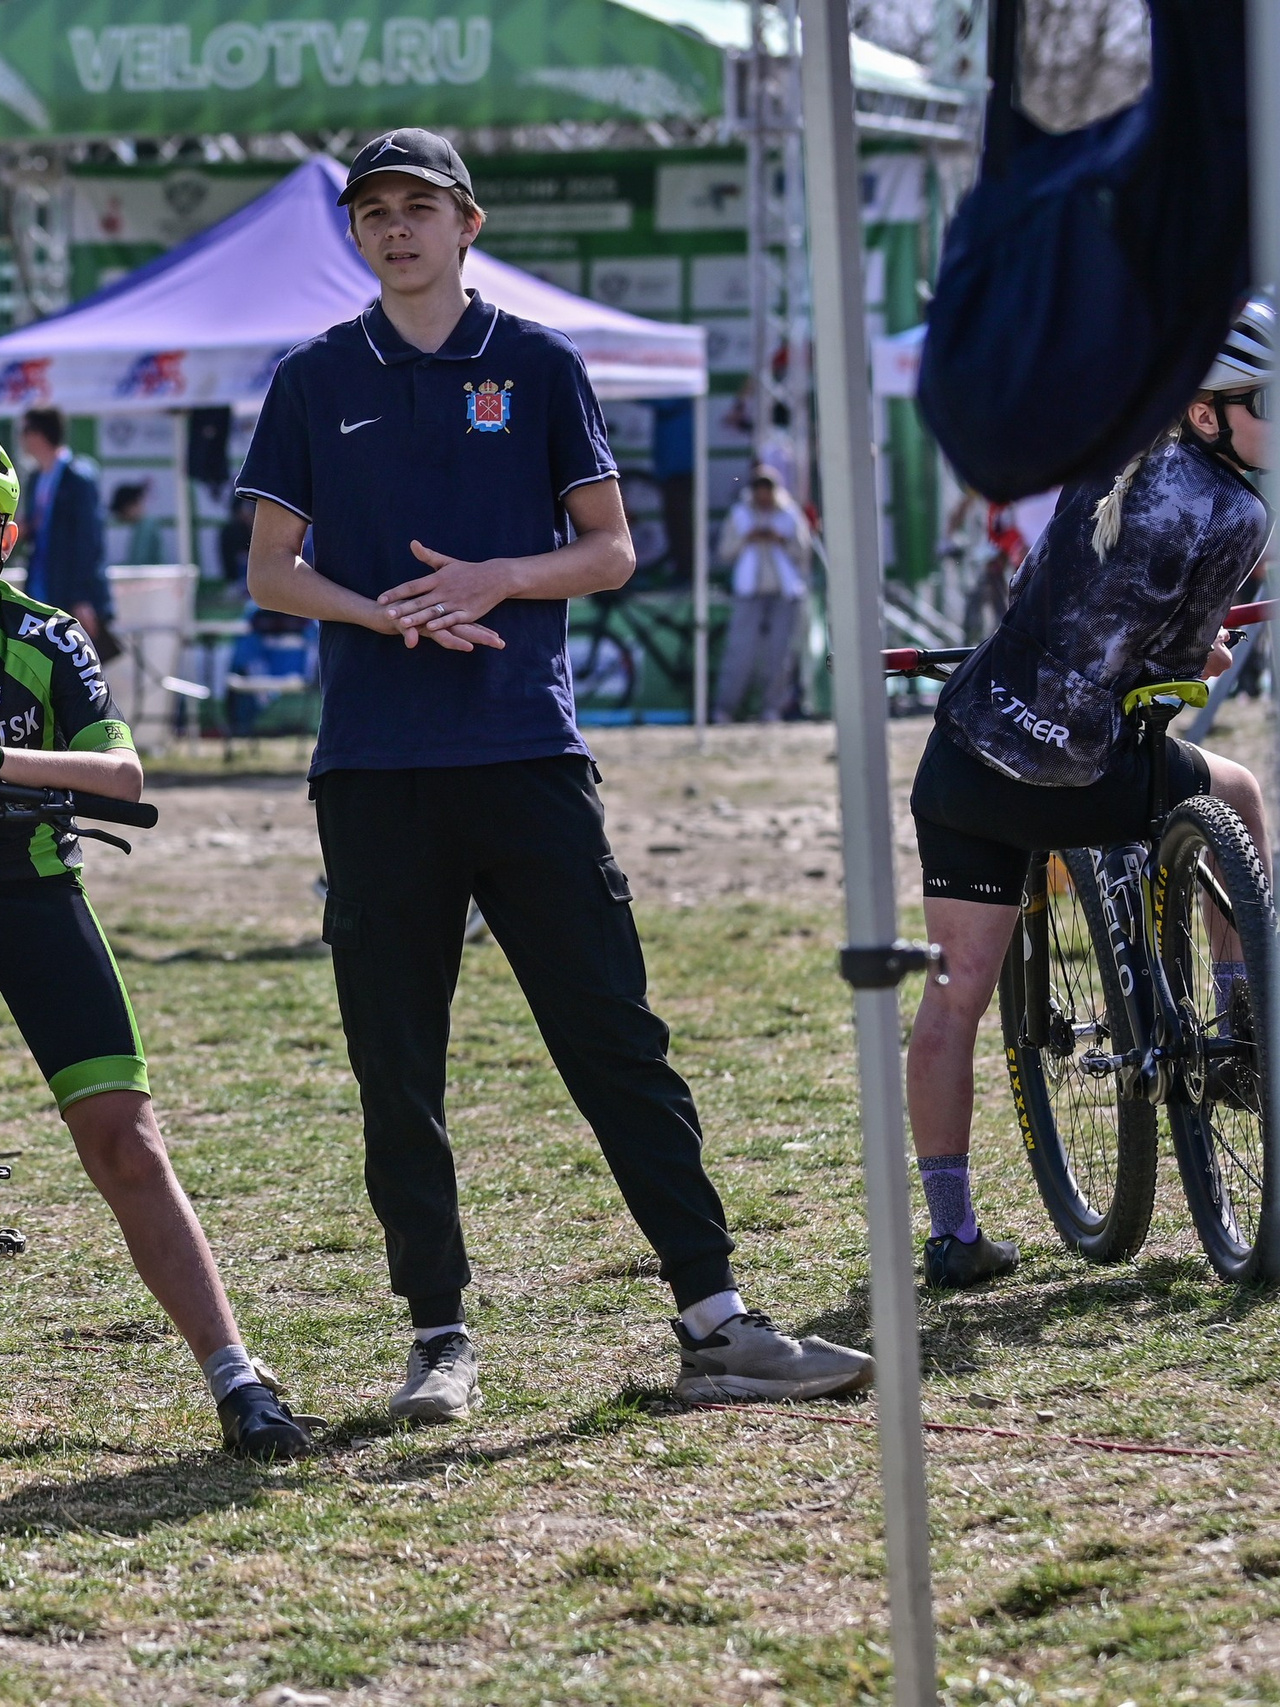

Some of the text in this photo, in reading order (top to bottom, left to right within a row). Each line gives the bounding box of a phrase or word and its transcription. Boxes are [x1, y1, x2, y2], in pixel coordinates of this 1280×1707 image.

[68, 16, 492, 93] VELOTV.RU
[17, 612, 108, 702] RUSSIA
[1006, 1047, 1035, 1150] MAXXIS
